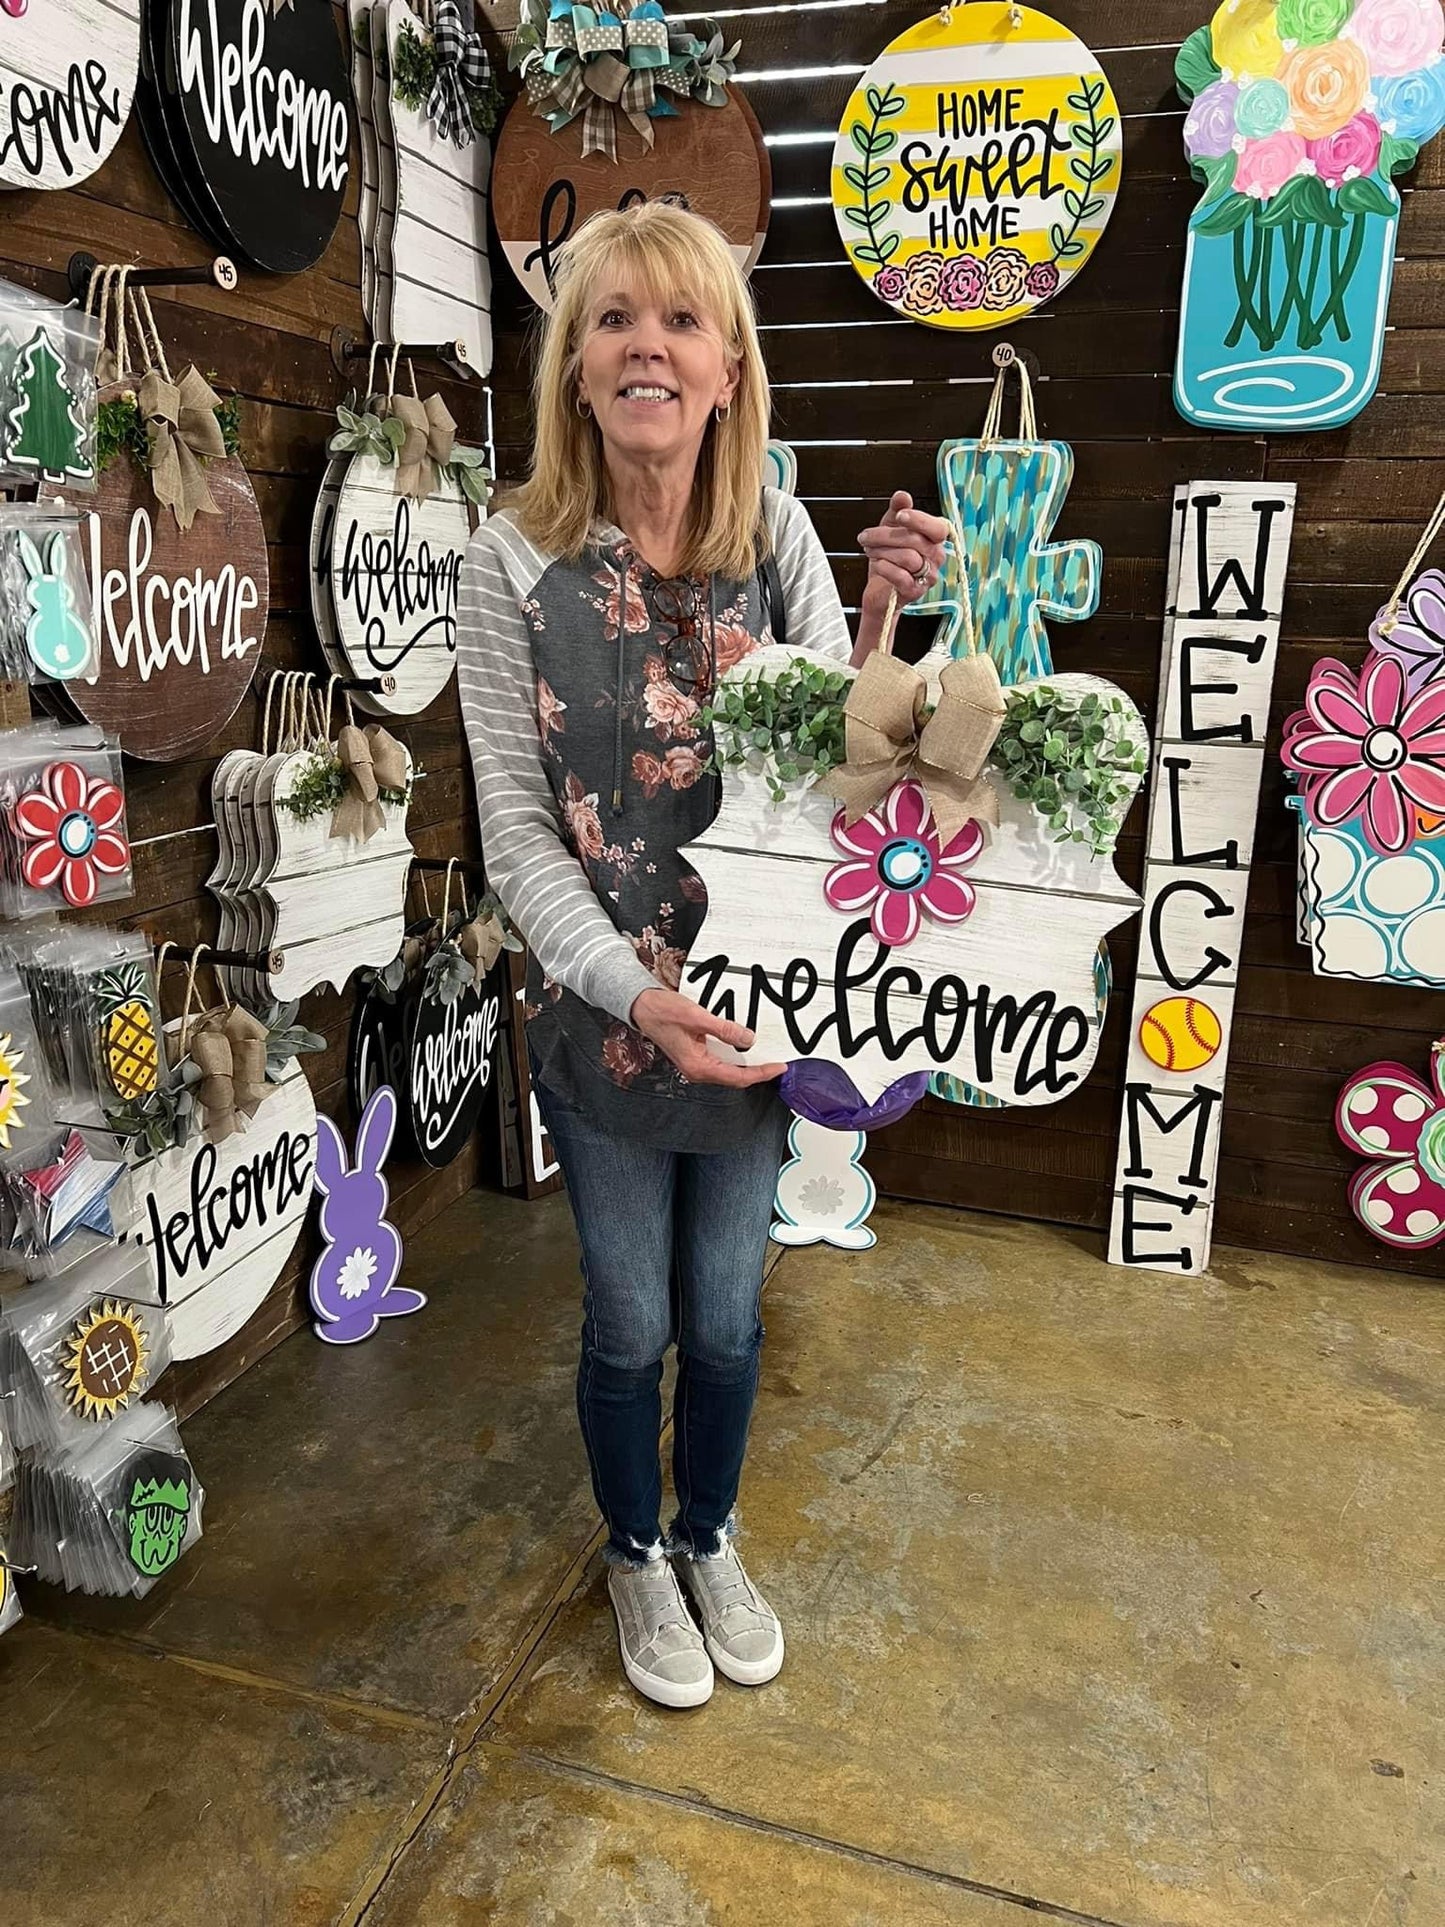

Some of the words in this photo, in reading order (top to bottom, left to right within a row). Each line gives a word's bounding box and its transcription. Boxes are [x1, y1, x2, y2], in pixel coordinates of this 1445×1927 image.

[180, 0, 348, 191] Welcome
[938, 88, 1025, 141] HOME
[929, 204, 1020, 250] HOME
[218, 263, 234, 282] 45
[457, 343, 467, 357] 45
[996, 348, 1012, 362] 40
[384, 677, 396, 692] 40
[271, 954, 284, 969] 45
[118, 1131, 313, 1304] elcome
